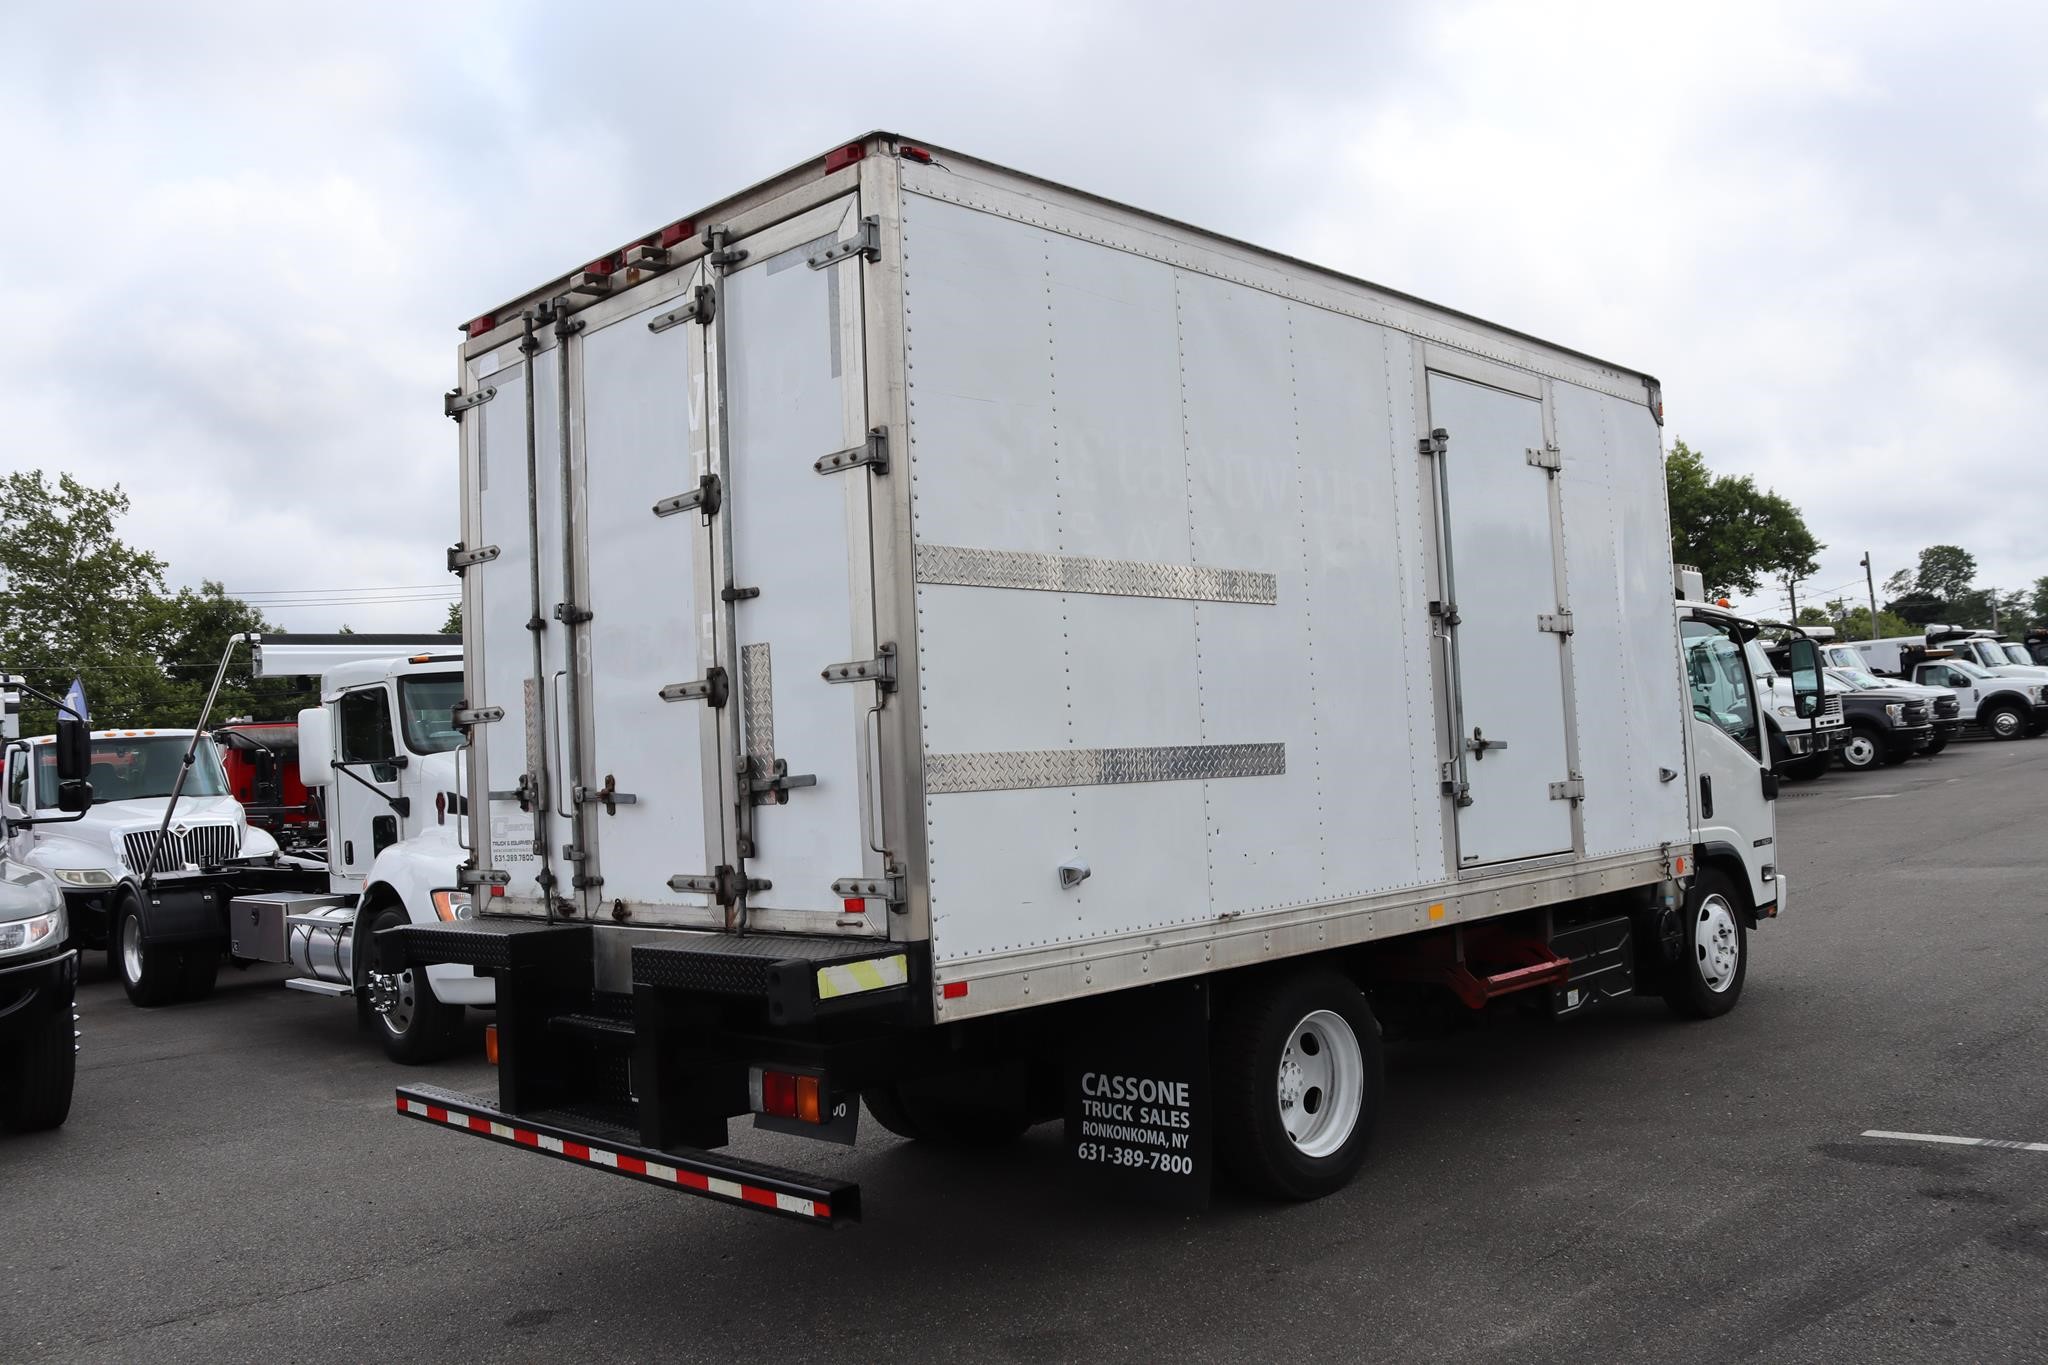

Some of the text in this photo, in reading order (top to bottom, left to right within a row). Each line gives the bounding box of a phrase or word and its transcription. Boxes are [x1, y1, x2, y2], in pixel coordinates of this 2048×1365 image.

[1081, 1072, 1190, 1107] CASSONE
[1082, 1099, 1190, 1129] TRUCK SALES
[1082, 1120, 1189, 1149] RONKONKOMA, NY
[1078, 1142, 1193, 1175] 631-389-7800
